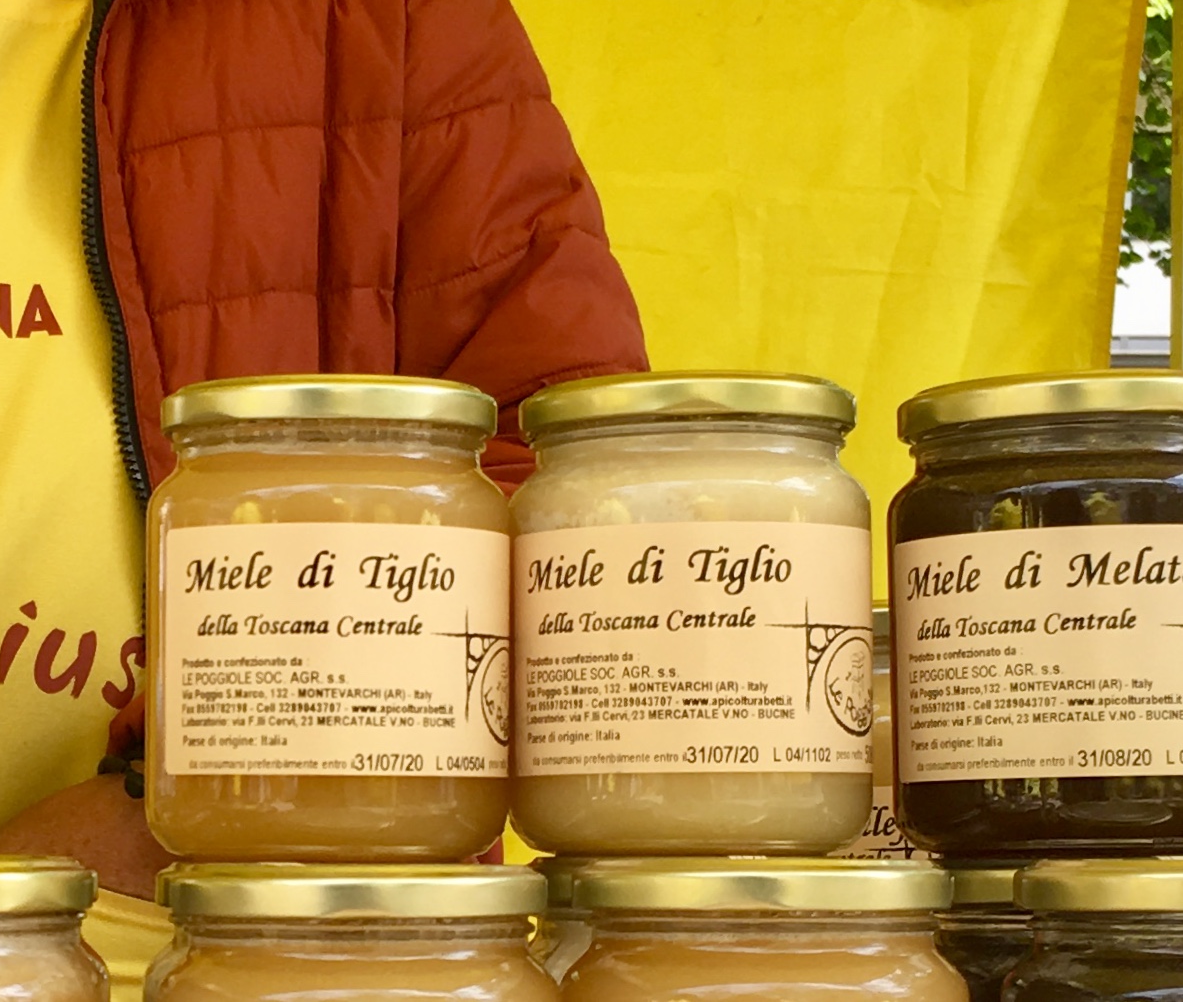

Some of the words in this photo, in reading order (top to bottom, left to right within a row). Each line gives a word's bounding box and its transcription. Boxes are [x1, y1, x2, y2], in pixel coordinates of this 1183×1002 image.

[185, 551, 273, 594] Miele
[297, 550, 336, 589] di
[359, 552, 455, 603] Tiglio
[528, 549, 604, 594] Miele
[627, 545, 664, 585] di
[687, 544, 792, 595] Tiglio
[906, 554, 982, 602] Miele
[1004, 550, 1043, 590] di
[1066, 546, 1183, 589] Melat
[197, 614, 238, 637] della
[244, 613, 329, 636] Toscana
[337, 614, 423, 637] Centrale
[538, 612, 574, 636] della
[579, 609, 659, 633] Toscana
[666, 606, 756, 631] Centrale
[916, 618, 951, 642] della
[955, 614, 1036, 640] Toscana
[1043, 607, 1138, 635] Centrale
[561, 652, 619, 664] confezionato
[622, 652, 634, 662] da
[943, 647, 1001, 660] confezionato
[1004, 646, 1017, 656] da
[224, 656, 287, 667] confezionato
[290, 656, 303, 666] da
[182, 673, 193, 686] LE
[195, 671, 252, 685] POGGIOLE
[527, 671, 536, 684] LE
[537, 668, 587, 683] POGGIOLE
[909, 671, 918, 684] LE
[920, 666, 968, 682] POGGIOLE
[604, 683, 621, 694] 132
[629, 681, 712, 693] MONTEVARCHI
[715, 681, 739, 694] (AR)
[747, 682, 769, 694] Italy
[1010, 679, 1095, 692] MONTEVARCHI
[1098, 679, 1122, 692] (AR)
[1131, 679, 1153, 691] Italy
[271, 688, 288, 698] 132
[298, 688, 381, 698] MONTEVARCHI
[384, 688, 406, 701] (AR)
[414, 690, 433, 702] Italy
[682, 696, 792, 708] www.apicolturabetti.it
[1067, 695, 1183, 708] www.apicolturabetti.it
[301, 716, 313, 726] 23
[317, 715, 386, 726] MERCATALE
[423, 717, 456, 728] BUCINE
[632, 710, 645, 720] 23
[648, 709, 719, 719] MERCATALE
[758, 709, 795, 720] BUCINE
[1016, 714, 1029, 724] 23
[1032, 711, 1105, 723] MERCATALE
[1146, 709, 1183, 721] BUCINE
[208, 735, 216, 746] di
[261, 735, 288, 746] Italia
[548, 731, 556, 743] di
[595, 730, 621, 741] Italia
[931, 739, 938, 750] di
[977, 736, 1003, 747] Italia
[687, 746, 759, 764] 31/07/20
[773, 747, 781, 763] L
[785, 747, 831, 763] 04/1102
[1039, 756, 1065, 767] entro
[1077, 748, 1152, 767] 31/08/20
[1166, 750, 1175, 765] L
[354, 754, 424, 772] 31/07/20
[436, 756, 443, 771] L
